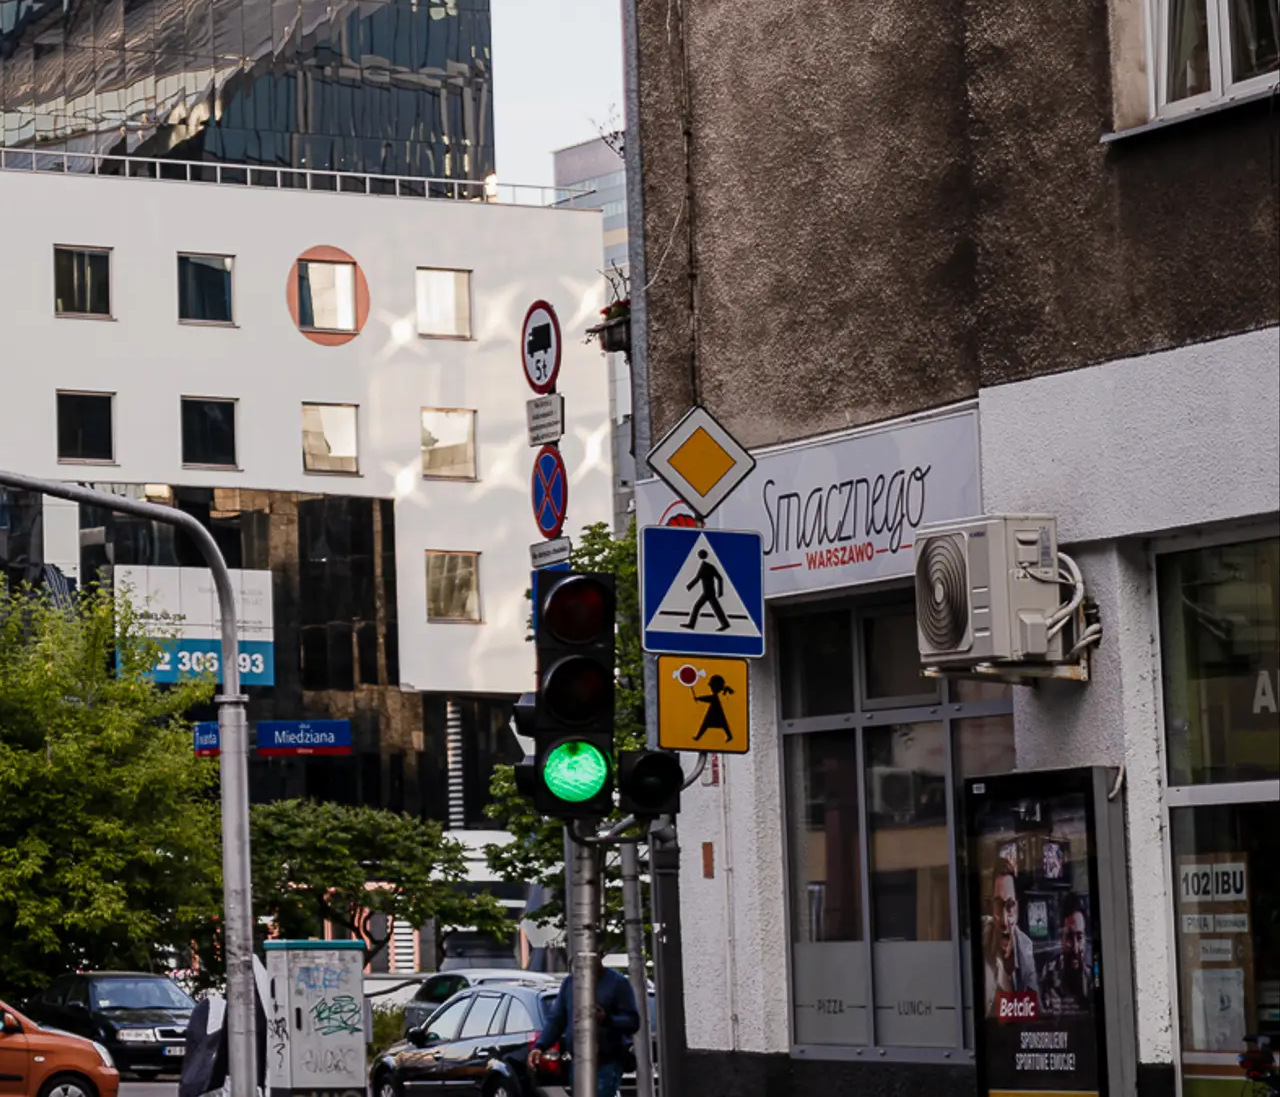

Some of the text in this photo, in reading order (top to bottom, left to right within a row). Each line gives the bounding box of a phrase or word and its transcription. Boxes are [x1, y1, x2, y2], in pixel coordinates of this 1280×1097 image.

[535, 358, 548, 381] 5t
[763, 464, 931, 556] Smacznego
[806, 541, 874, 571] WARSZAWO
[274, 729, 336, 745] Miedziana
[1181, 870, 1244, 896] 102 IBU
[816, 999, 845, 1015] PIZZA
[897, 1000, 932, 1016] LUNCH
[999, 996, 1035, 1017] Betclic
